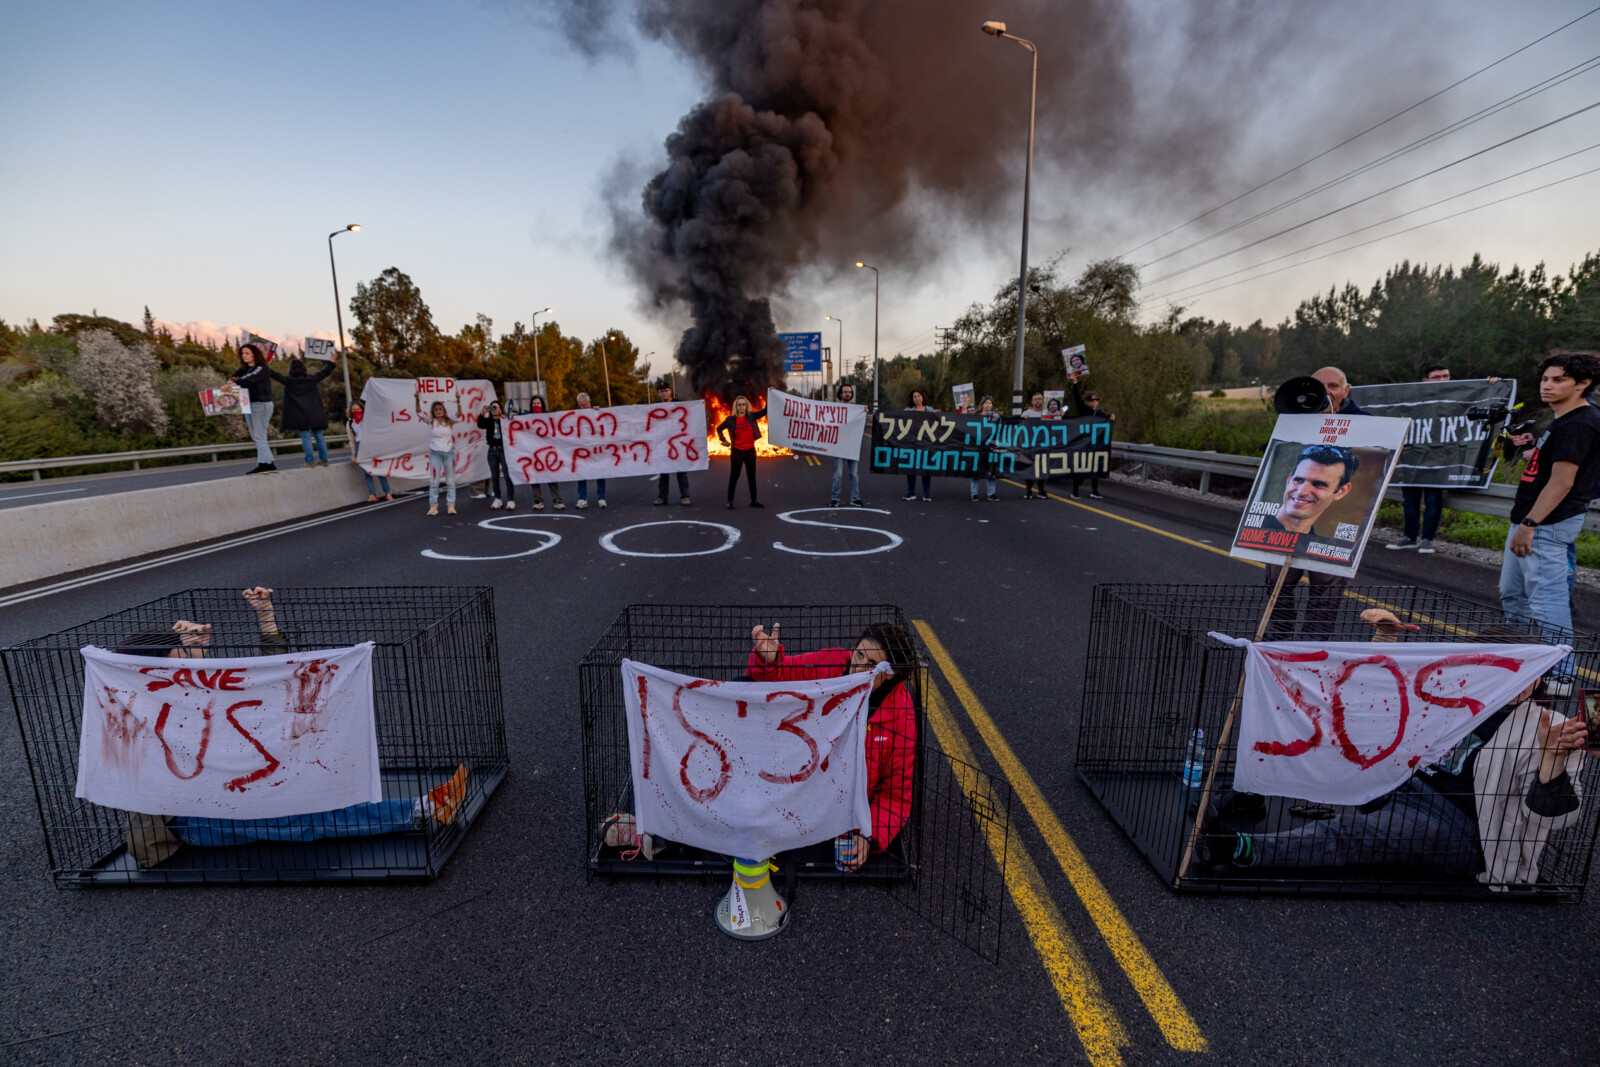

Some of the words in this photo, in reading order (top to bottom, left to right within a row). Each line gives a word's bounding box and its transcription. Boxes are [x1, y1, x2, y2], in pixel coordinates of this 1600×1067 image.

[308, 340, 334, 354] HELP
[418, 379, 454, 393] HELP
[646, 406, 689, 433] דם
[783, 398, 811, 420] אותם
[815, 404, 848, 424] תוציאו
[508, 411, 618, 446] החטופים
[879, 412, 913, 440] על
[917, 416, 956, 443] לא
[964, 416, 1068, 448] הממשלה
[1079, 423, 1111, 446] חיי
[1319, 427, 1338, 435] DROR
[1337, 427, 1348, 435] OR
[571, 441, 651, 473] הידיים
[666, 433, 699, 462] על
[874, 446, 980, 472] החטופים
[517, 446, 564, 483] שלך
[988, 452, 1015, 474] חיי
[1034, 451, 1109, 479] חשבון
[1244, 514, 1265, 528] HIM
[1249, 501, 1280, 516] BRING
[420, 507, 904, 560] SOS
[1240, 528, 1268, 543] HOME
[1267, 531, 1299, 548] NOW!
[1306, 545, 1331, 557] FAMILIES
[1330, 550, 1351, 560] FORUM
[139, 668, 249, 691] SAVE
[1253, 650, 1524, 771] SOS
[155, 699, 281, 793] US
